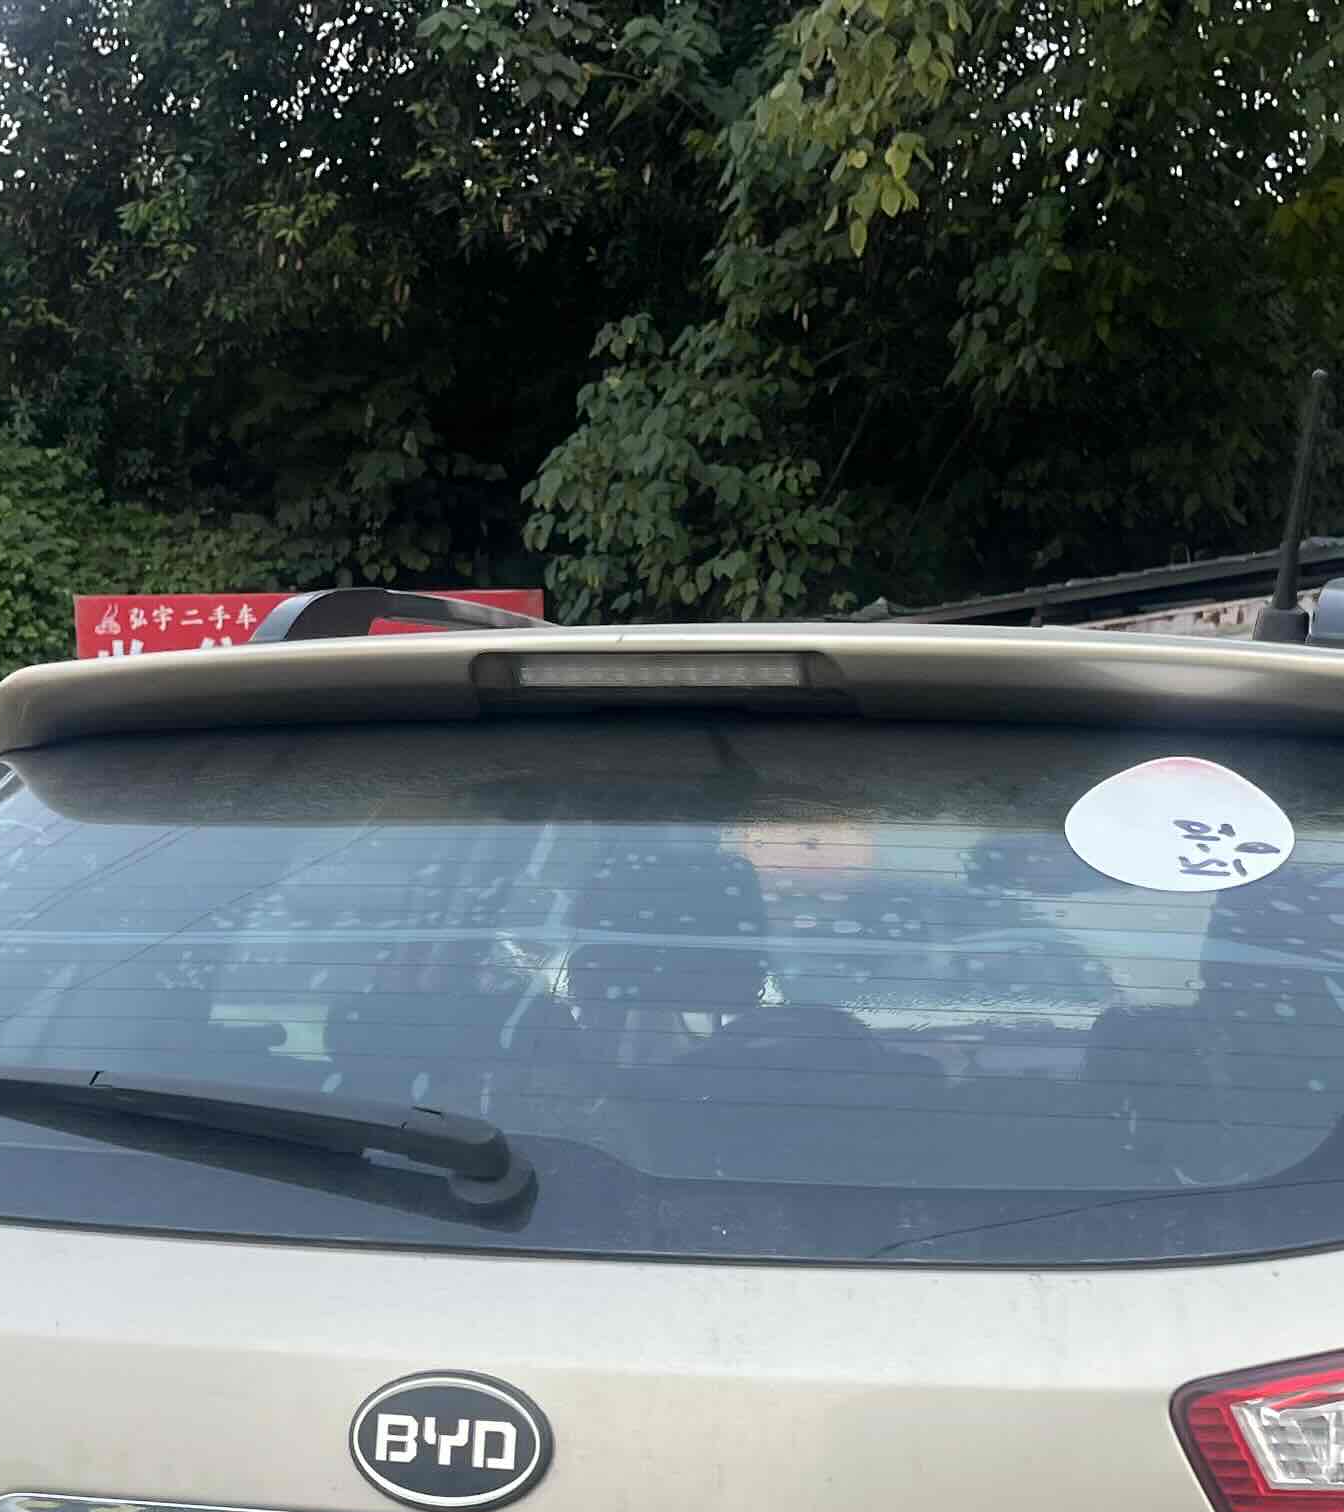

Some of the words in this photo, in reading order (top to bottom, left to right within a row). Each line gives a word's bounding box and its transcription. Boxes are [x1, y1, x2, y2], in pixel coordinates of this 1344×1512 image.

[129, 603, 257, 631] 弘宇二手车
[374, 1412, 518, 1471] BYD
